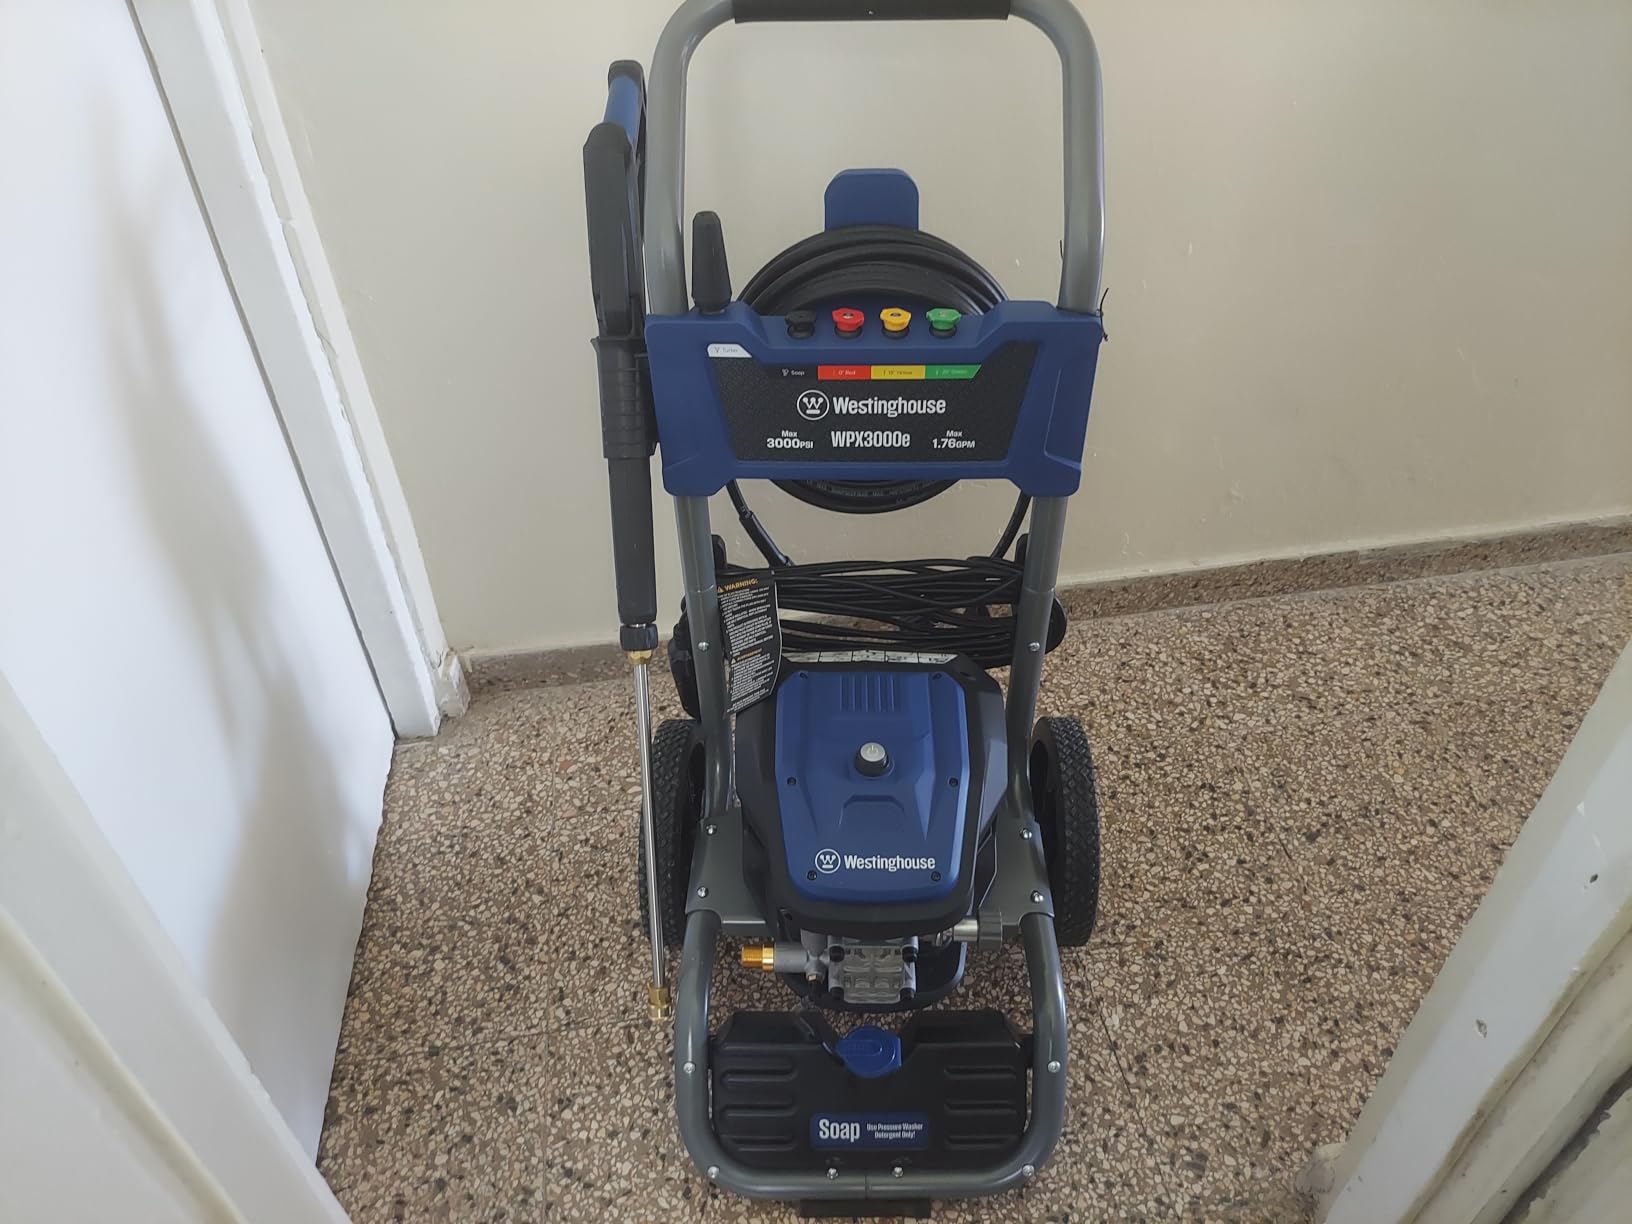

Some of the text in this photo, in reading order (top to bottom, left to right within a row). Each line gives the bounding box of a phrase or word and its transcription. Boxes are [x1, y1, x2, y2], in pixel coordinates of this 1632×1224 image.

[832, 397, 946, 418] Westinghouse
[831, 430, 911, 448] WPX3000e
[843, 855, 936, 872] Westinghouse
[818, 1118, 860, 1143] Soap
[866, 1122, 924, 1131] Use Pressure Washer
[874, 1131, 916, 1140] Detergent Only!
